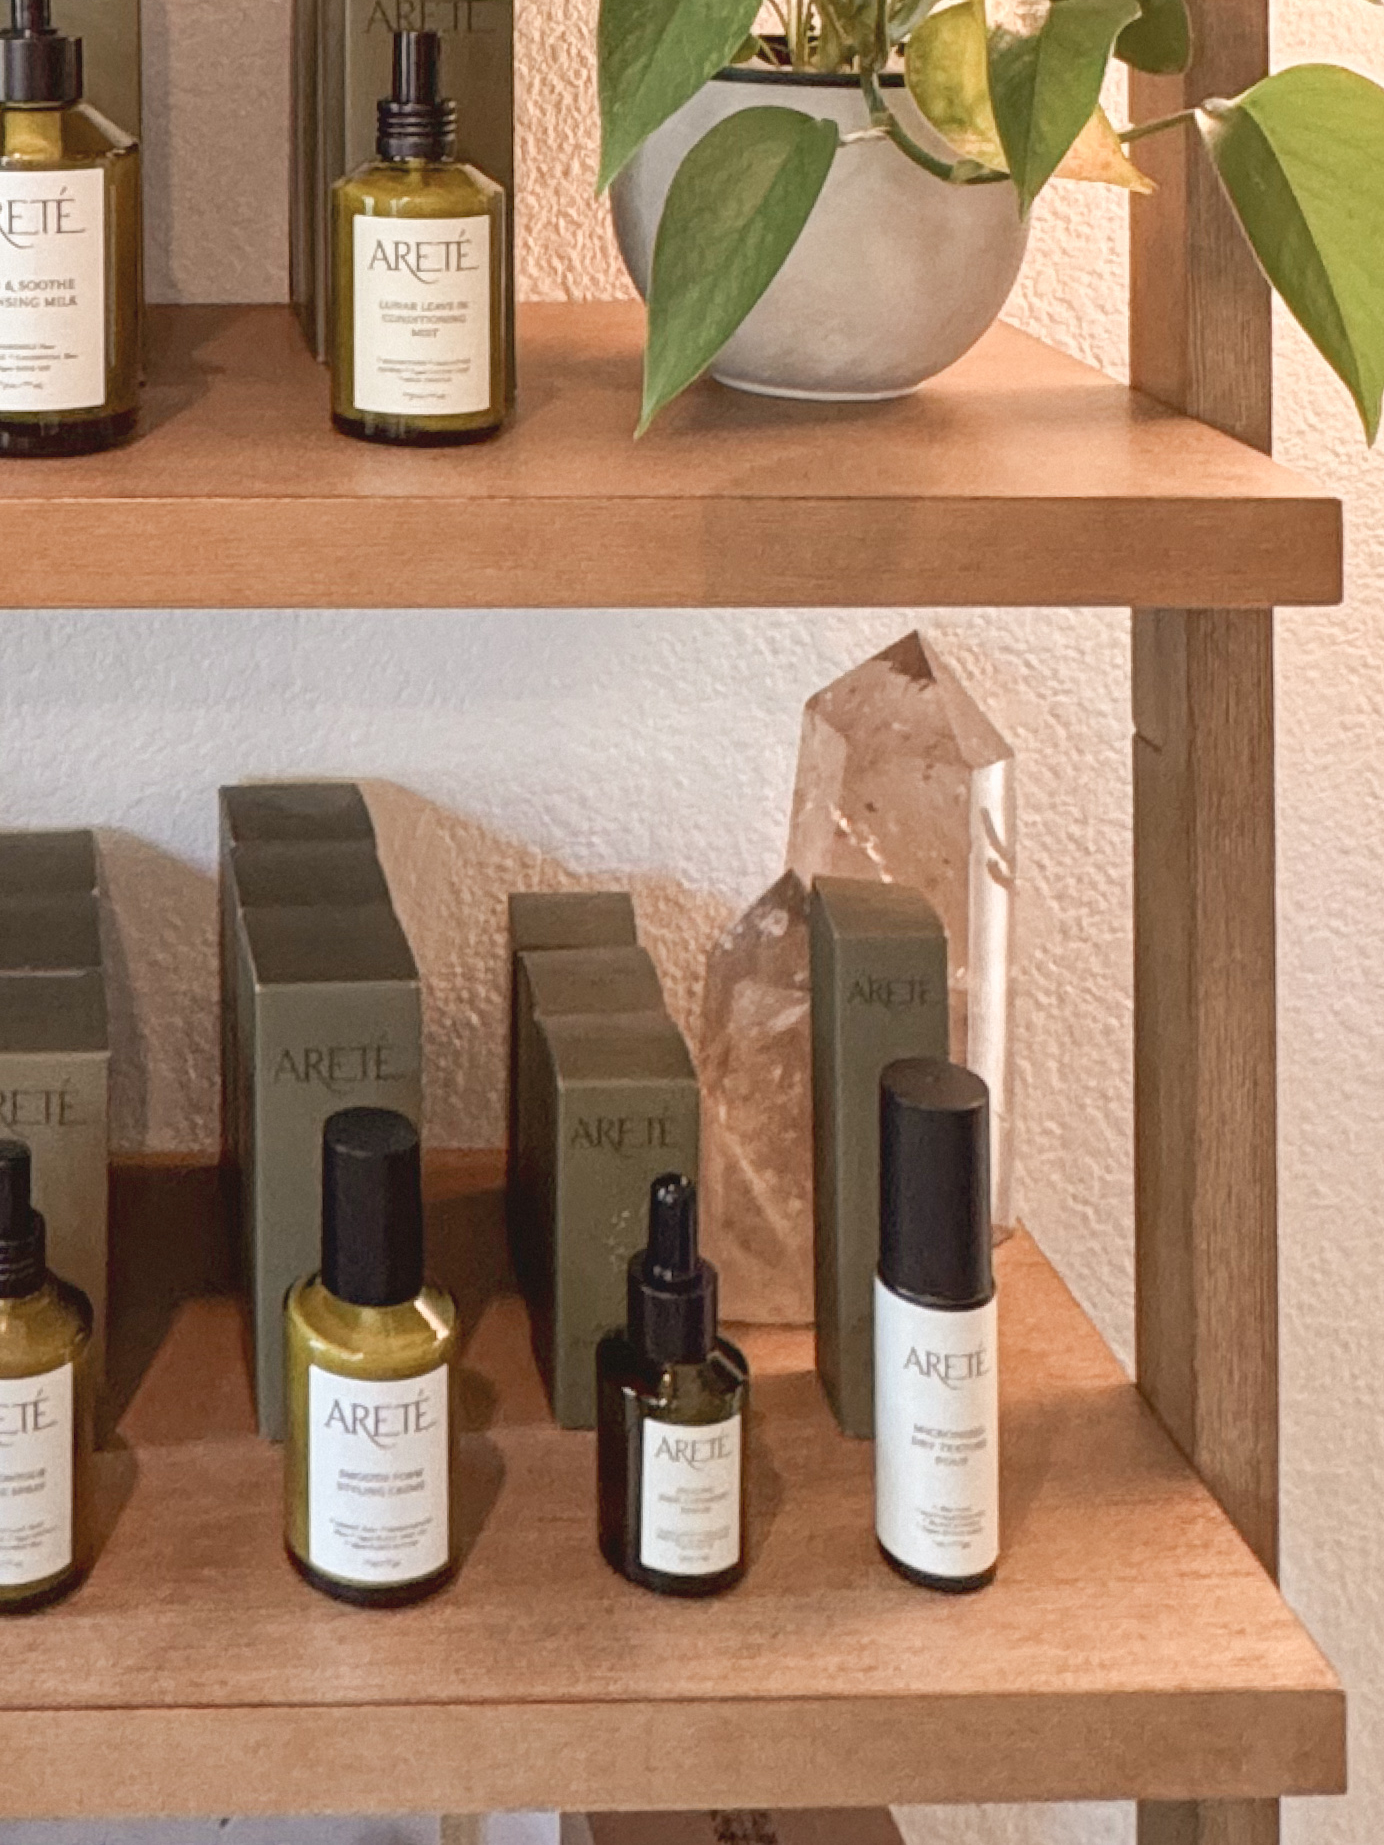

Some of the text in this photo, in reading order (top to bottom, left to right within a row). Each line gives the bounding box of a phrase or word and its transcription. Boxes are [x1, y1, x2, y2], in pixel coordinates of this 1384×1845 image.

[368, 228, 480, 284] ARETÉ
[5, 280, 17, 292] &
[19, 278, 76, 291] SOOTHE
[44, 295, 79, 307] MILK
[274, 1031, 408, 1096] ARETÉ
[903, 1342, 990, 1390] ARETÉ
[324, 1388, 437, 1450] ARETÉ
[655, 1427, 733, 1471] ARETÉ
